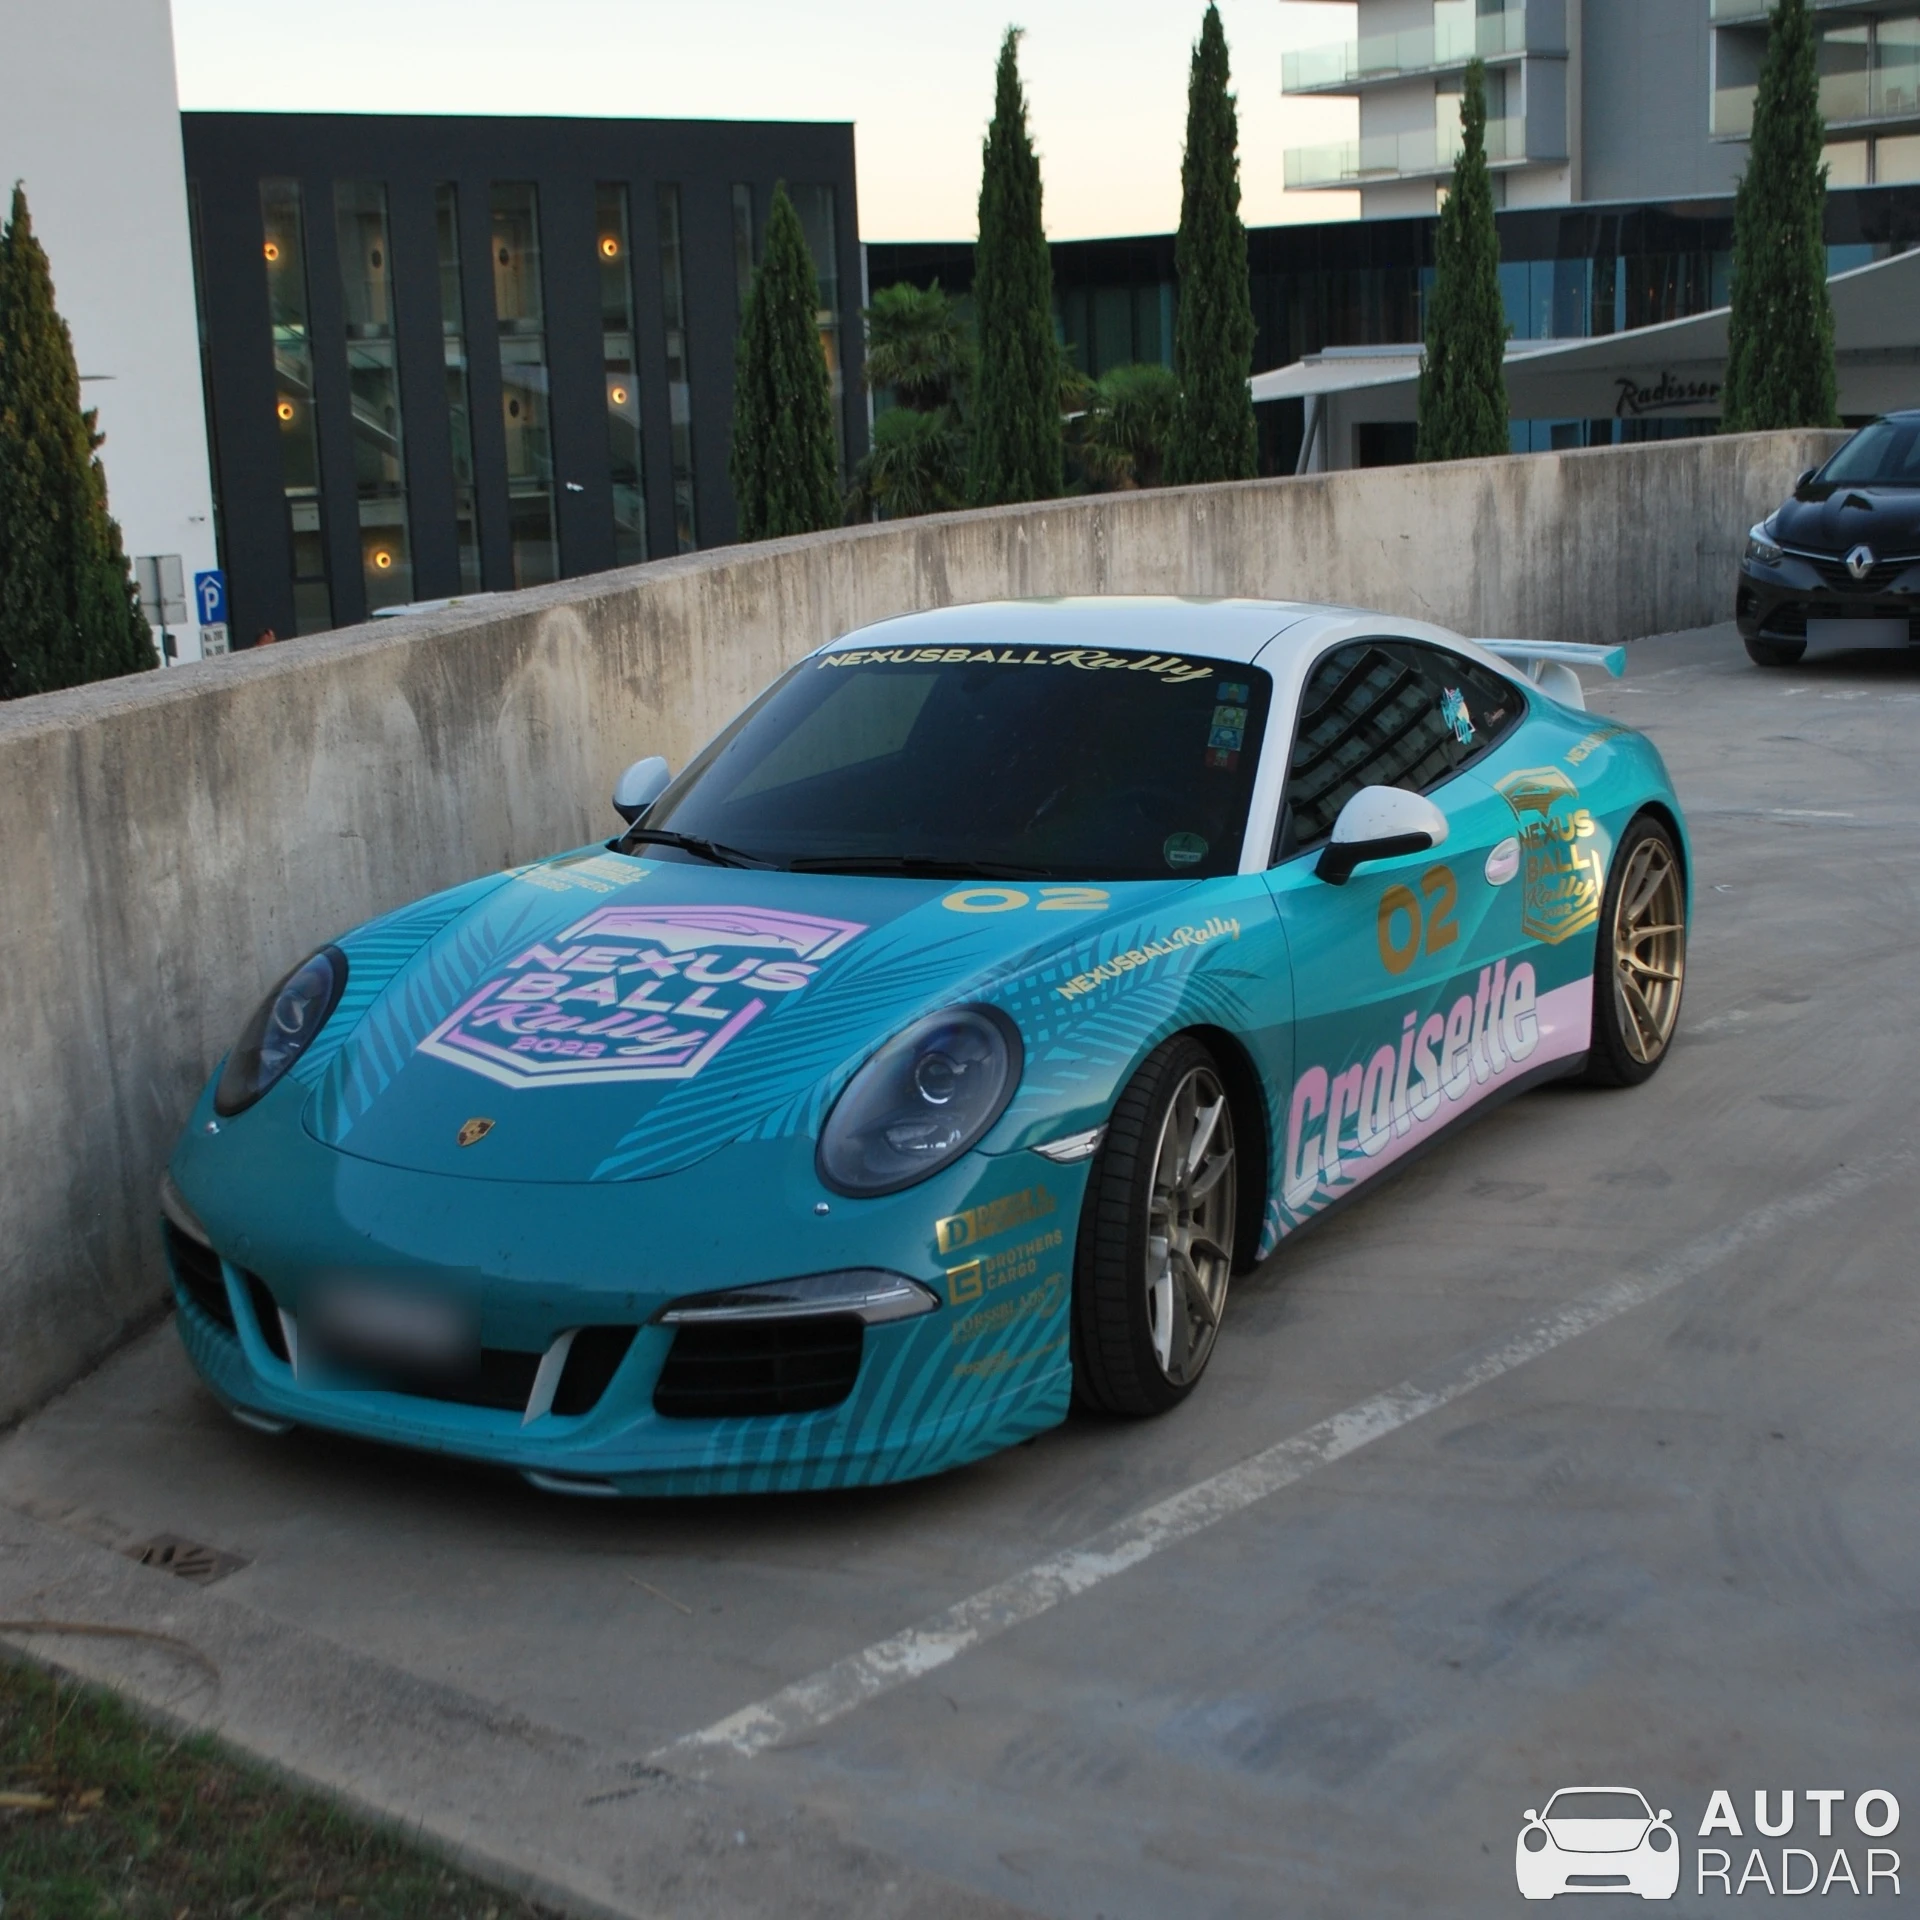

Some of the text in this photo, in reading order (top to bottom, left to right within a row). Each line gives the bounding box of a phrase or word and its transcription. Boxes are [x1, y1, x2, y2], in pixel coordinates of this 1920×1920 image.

[204, 587, 219, 621] P
[1518, 808, 1595, 856] NEXUS
[1527, 844, 1591, 883] BALL
[1528, 875, 1596, 909] Rally
[505, 944, 821, 992] NEXUS
[497, 972, 732, 1020] BALL
[471, 1001, 708, 1055] Rally
[507, 1036, 607, 1058] 2022
[1284, 958, 1540, 1210] Croisette
[986, 1229, 1062, 1273] BROTHERS
[987, 1259, 1036, 1290] CARGO
